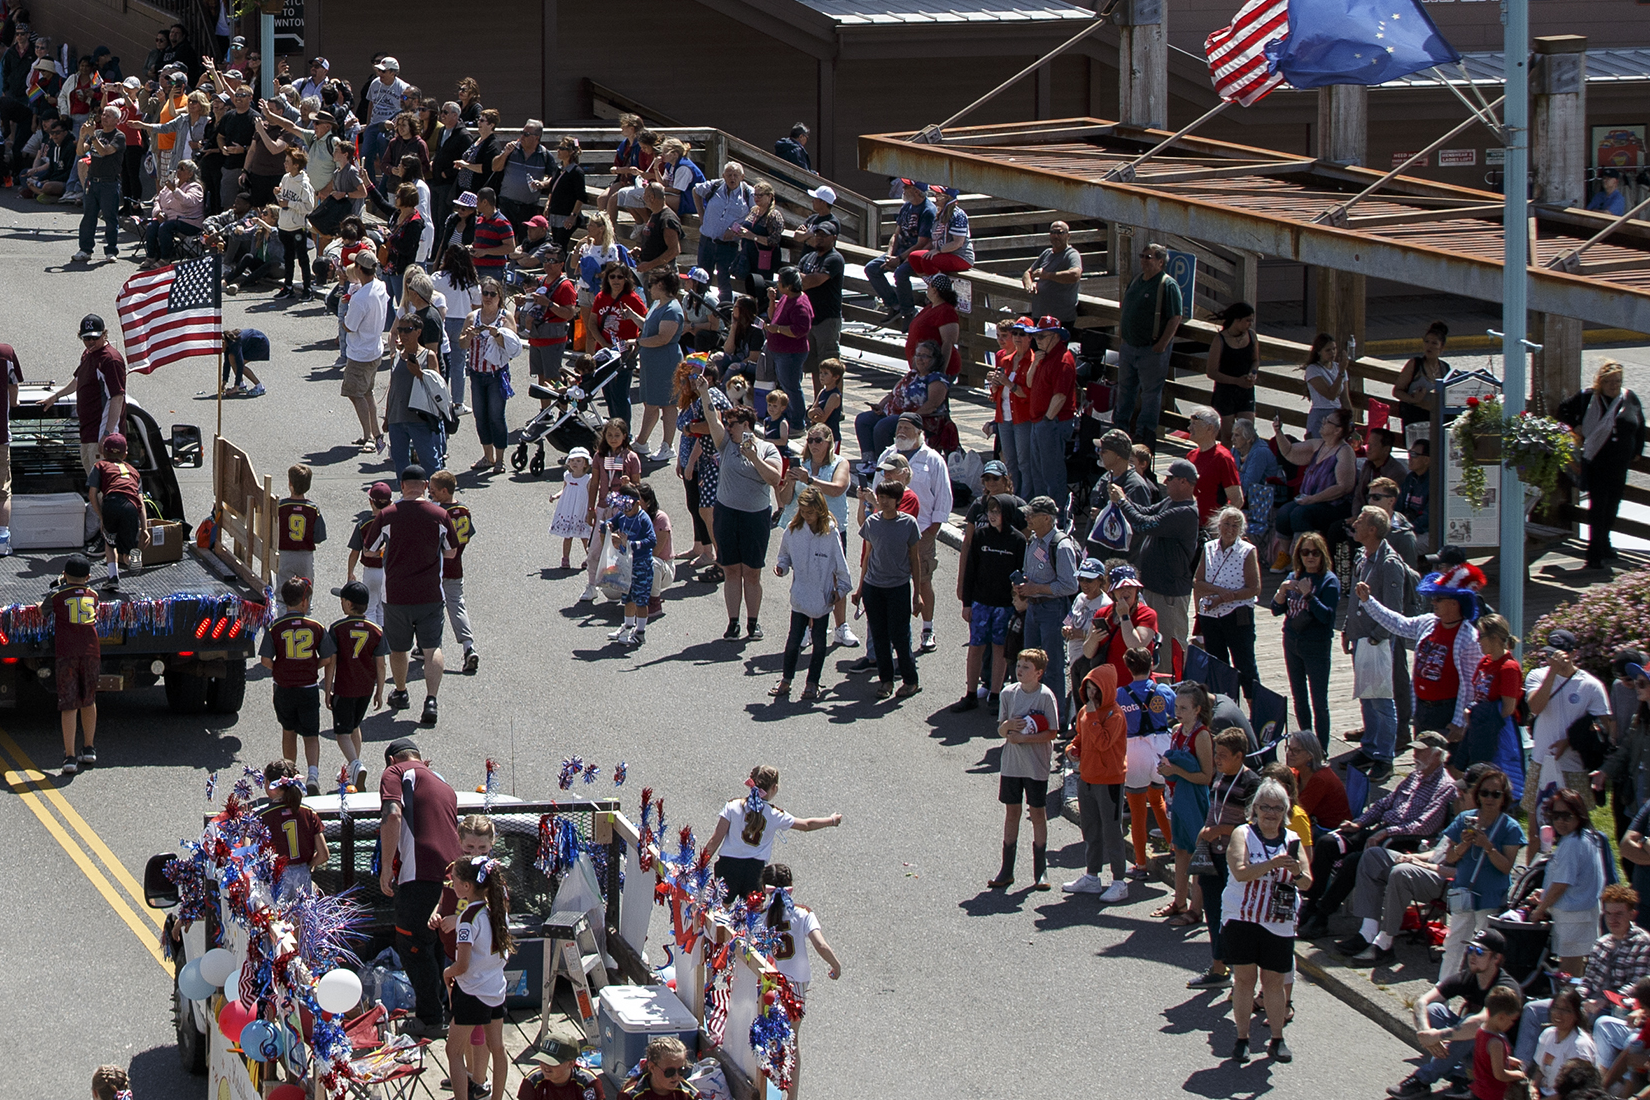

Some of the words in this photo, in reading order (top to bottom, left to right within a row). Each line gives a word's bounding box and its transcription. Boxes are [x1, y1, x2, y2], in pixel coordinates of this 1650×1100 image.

[283, 8, 295, 16] TO
[288, 513, 307, 542] 9
[64, 596, 96, 624] 15
[281, 628, 314, 660] 12
[350, 630, 369, 659] 7
[1120, 703, 1140, 713] Rota
[281, 818, 300, 859] 1
